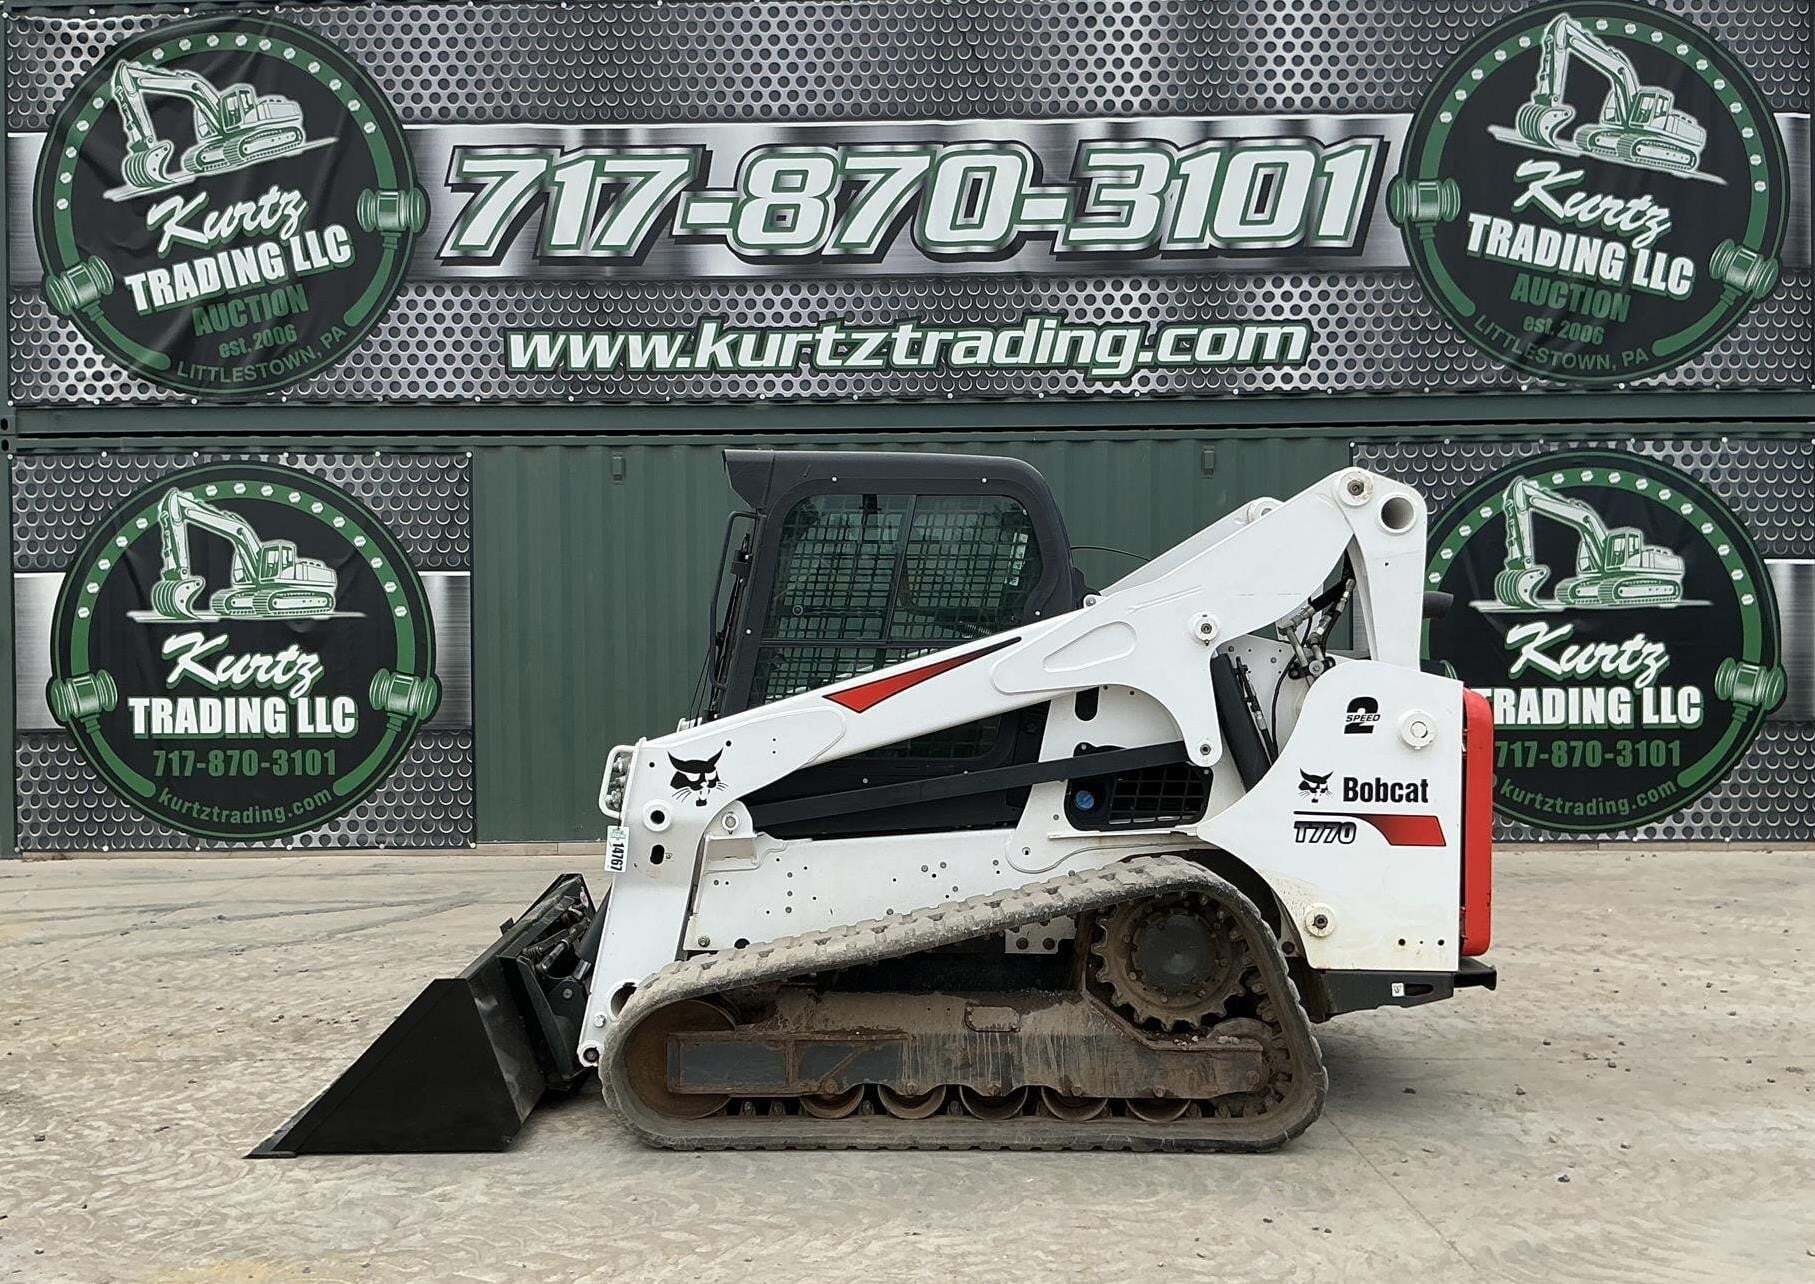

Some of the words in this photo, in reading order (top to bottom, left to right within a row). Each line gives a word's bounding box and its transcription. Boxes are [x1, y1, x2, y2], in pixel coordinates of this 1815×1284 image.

[148, 186, 306, 253] Kurtz
[447, 146, 1373, 252] 717-870-3101
[1513, 160, 1671, 247] Kurtz
[124, 243, 286, 312] TRADING
[290, 225, 353, 273] LLC
[1468, 213, 1625, 282] TRADING
[1632, 247, 1695, 296] LLC
[193, 285, 309, 336] AUCTION
[1511, 274, 1631, 322] AUCTION
[177, 346, 323, 383] LITTLESTOWN,
[320, 327, 347, 350] PA
[507, 319, 1310, 377] www.kurtztrading.com
[1474, 314, 1616, 371] LITTLESTOWN,
[1622, 348, 1648, 367] PA
[162, 633, 324, 698] Kurtz
[1506, 621, 1669, 688] Kurtz
[128, 697, 286, 735] TRADING
[297, 696, 356, 735] LLC
[1344, 696, 1378, 734] 2
[1345, 713, 1381, 723] SPEED
[1642, 686, 1702, 725] LLC
[153, 749, 336, 777] 717-870-3101
[1495, 740, 1681, 769] 717-870-3101
[159, 787, 332, 824] kurtztrading.com
[1343, 777, 1429, 803] Bobcat
[1500, 777, 1675, 817] kurtztrading.com
[610, 842, 625, 871] 14767
[1293, 820, 1357, 845] T770
